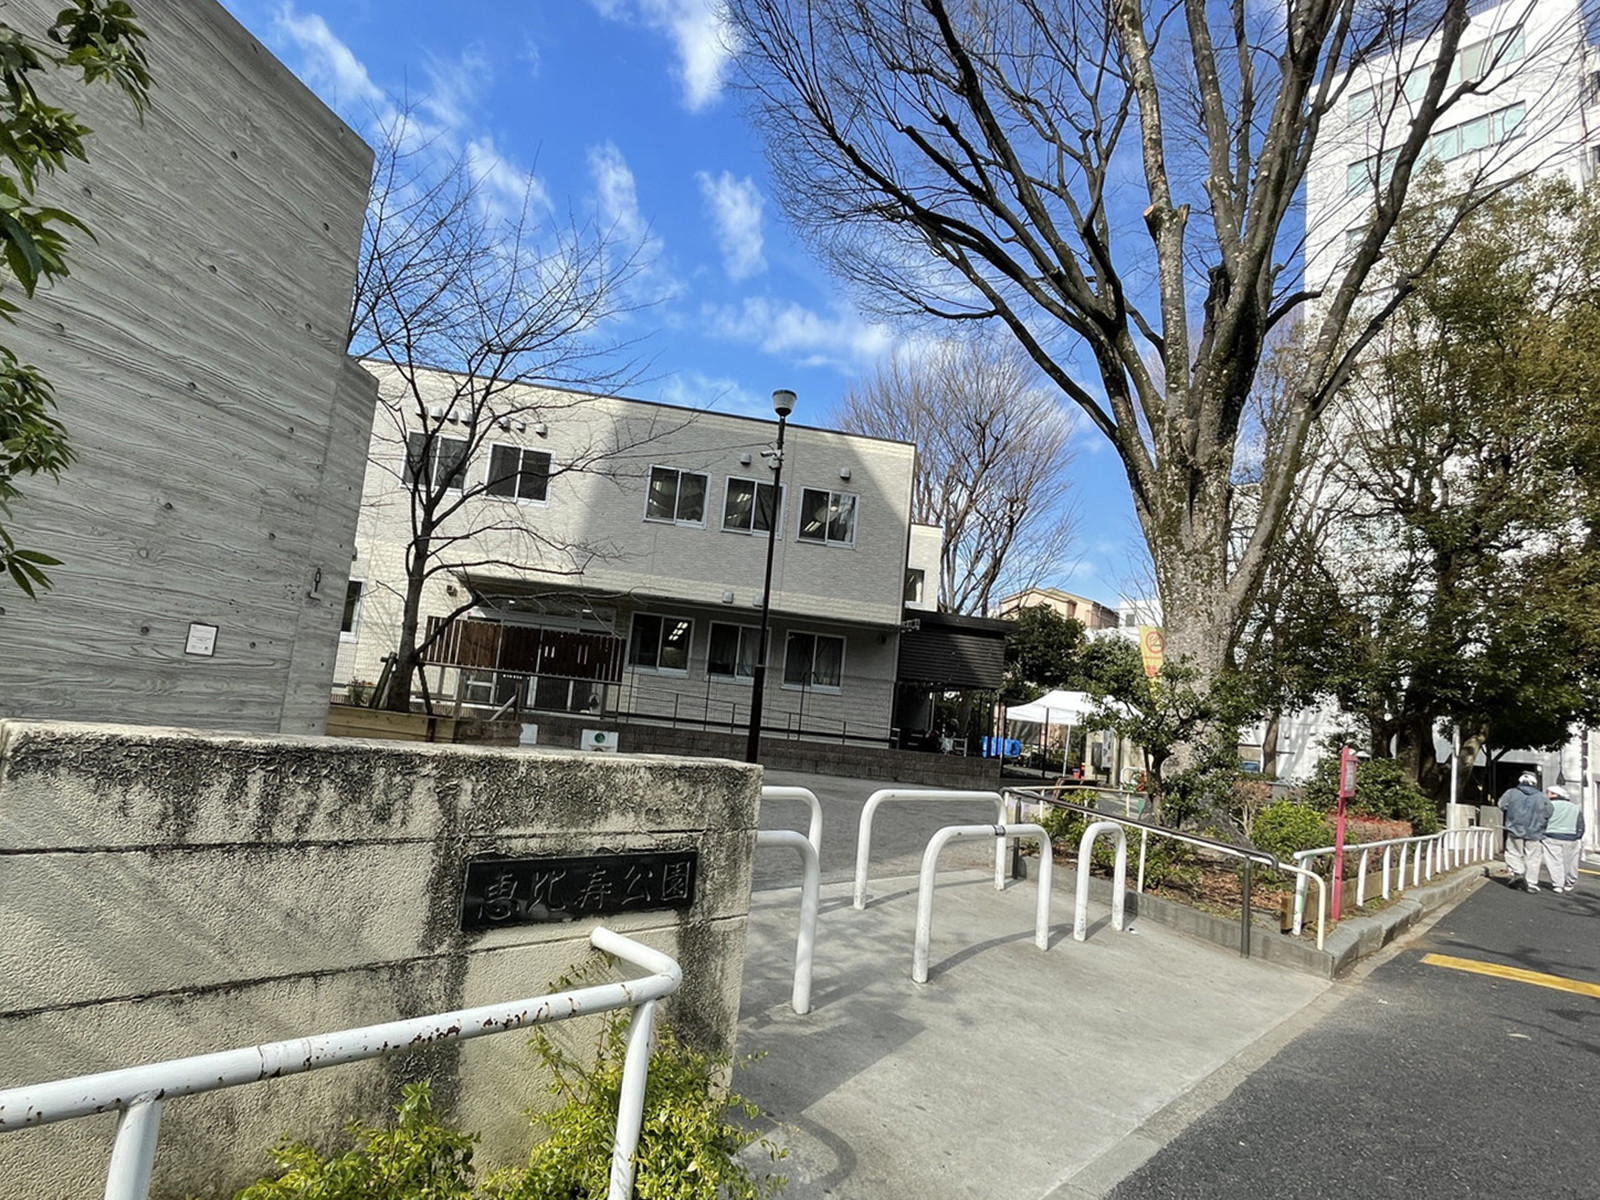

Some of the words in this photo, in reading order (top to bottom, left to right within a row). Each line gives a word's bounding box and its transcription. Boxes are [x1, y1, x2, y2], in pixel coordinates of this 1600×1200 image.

[478, 861, 690, 920] 恵比寿公園
